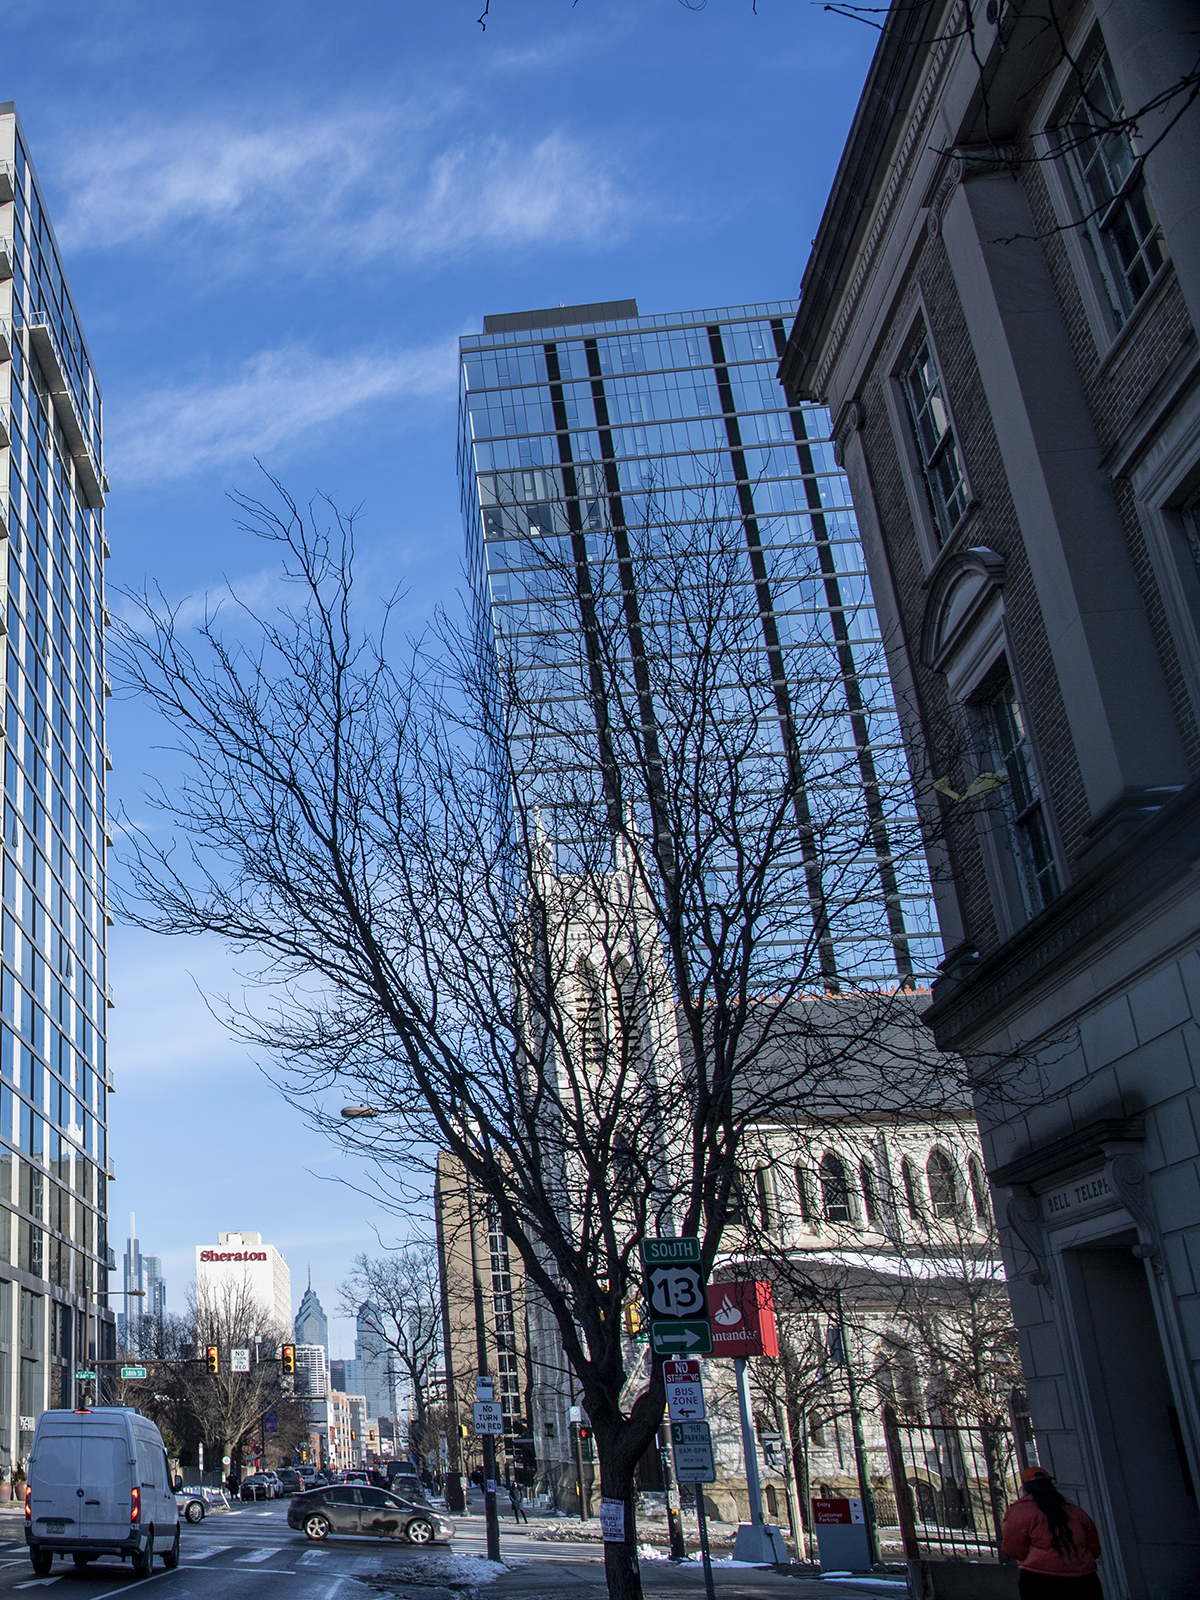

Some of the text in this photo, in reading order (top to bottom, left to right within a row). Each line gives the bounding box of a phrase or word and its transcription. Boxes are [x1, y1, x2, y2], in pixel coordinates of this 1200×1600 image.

[1047, 1193, 1071, 1213] BELL
[651, 1242, 693, 1257] SOUTH
[200, 1250, 267, 1262] Sheraton
[656, 1277, 697, 1308] 13
[675, 1362, 688, 1373] NO
[674, 1387, 694, 1396] BUS
[672, 1396, 699, 1405] ZONE
[674, 1426, 682, 1441] 3
[691, 1425, 701, 1433] HR
[684, 1433, 709, 1442] PARKING
